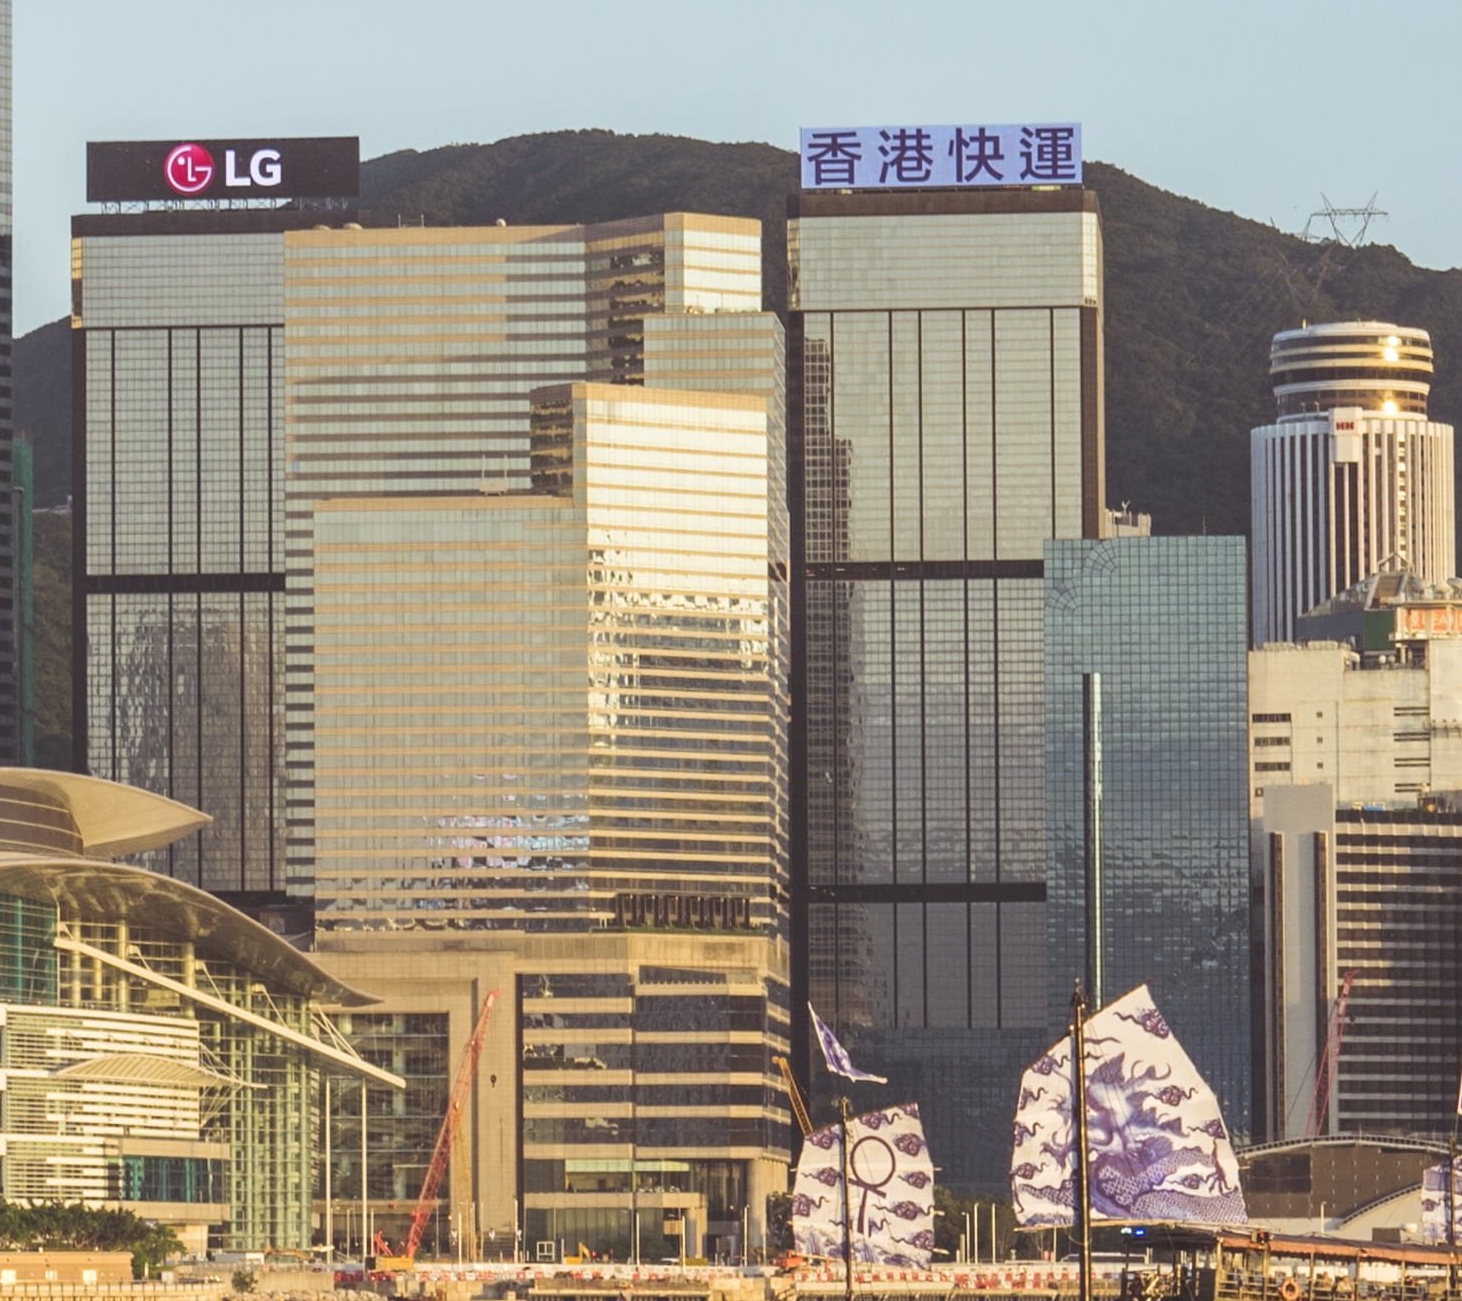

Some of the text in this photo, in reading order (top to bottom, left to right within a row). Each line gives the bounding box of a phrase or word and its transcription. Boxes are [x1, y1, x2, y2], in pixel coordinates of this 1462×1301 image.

[225, 149, 282, 187] LG
[807, 127, 1076, 186] 香港快運
